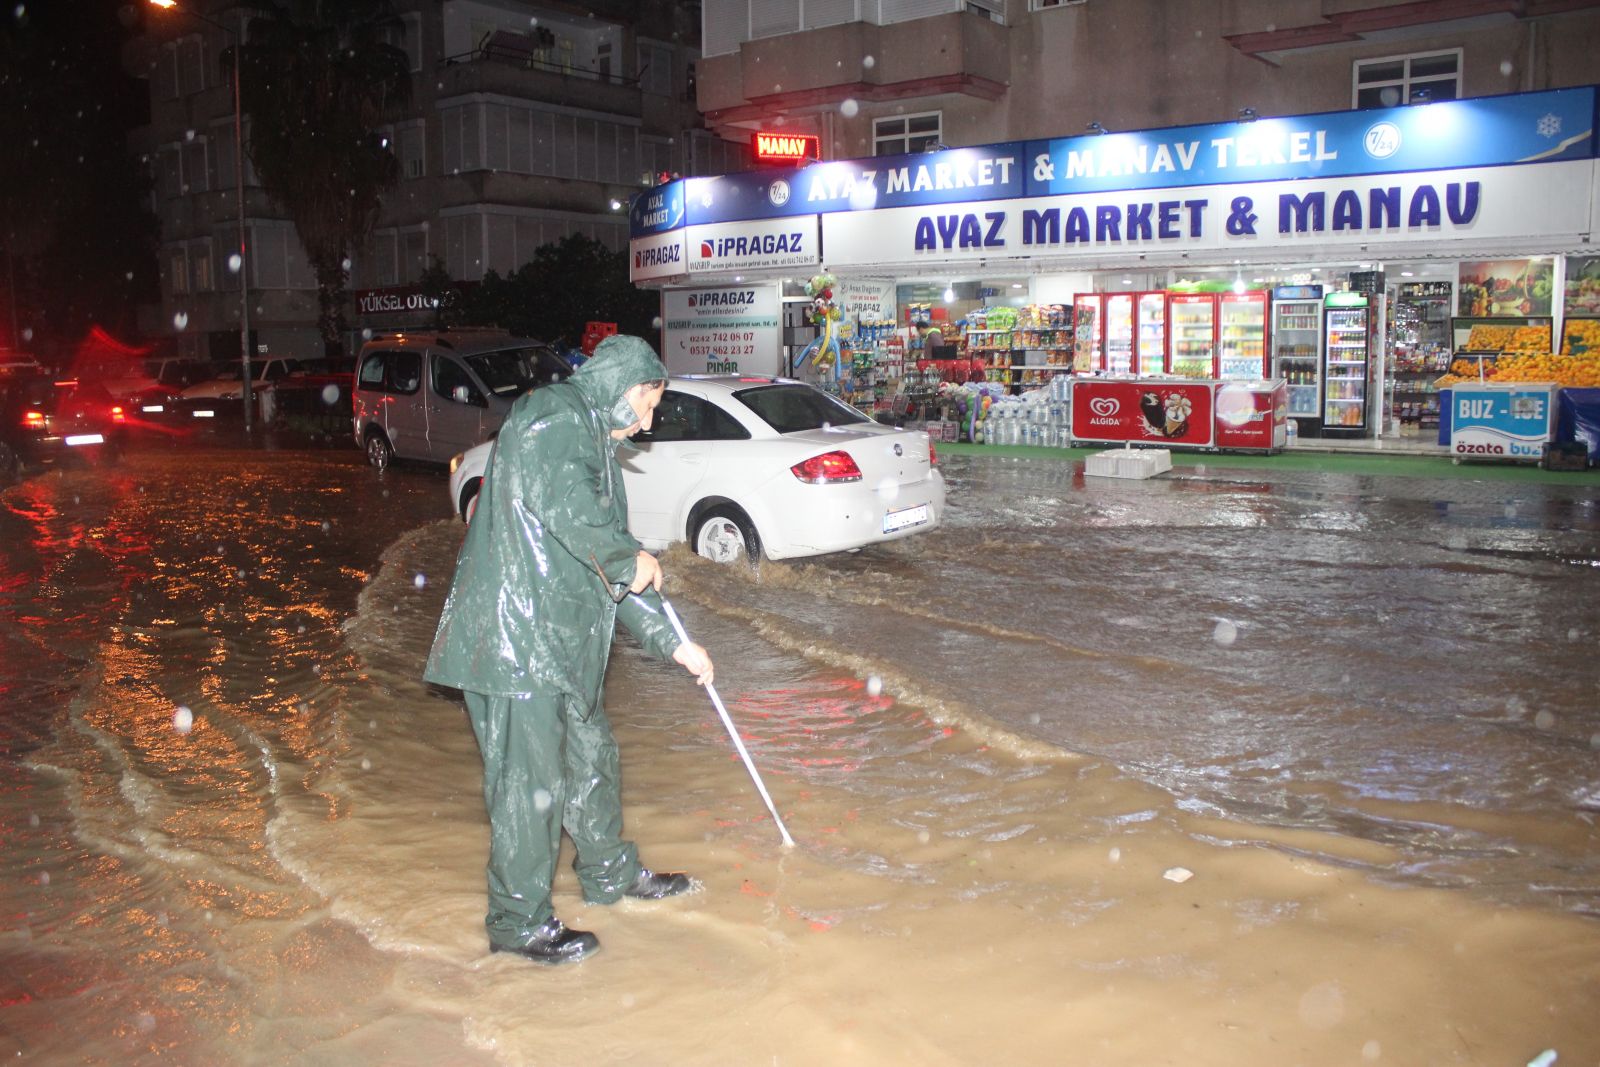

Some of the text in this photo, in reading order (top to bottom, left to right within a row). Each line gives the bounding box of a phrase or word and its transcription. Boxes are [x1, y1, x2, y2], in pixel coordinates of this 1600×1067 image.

[758, 137, 806, 156] MANAV
[808, 130, 1338, 201] AYAZ MARKET & MANAV TEKEL
[648, 194, 664, 211] AYAZ
[643, 209, 669, 228] MARKET
[915, 181, 1481, 251] AYAZ MARKET & MANAV
[360, 292, 405, 312] YÜKSEL
[690, 332, 754, 343] 0242 742 08 07
[690, 345, 710, 355] 0537
[730, 345, 741, 355] 23
[743, 344, 754, 354] 27
[1459, 399, 1494, 419] BUZ
[1456, 440, 1540, 456] özata buz
